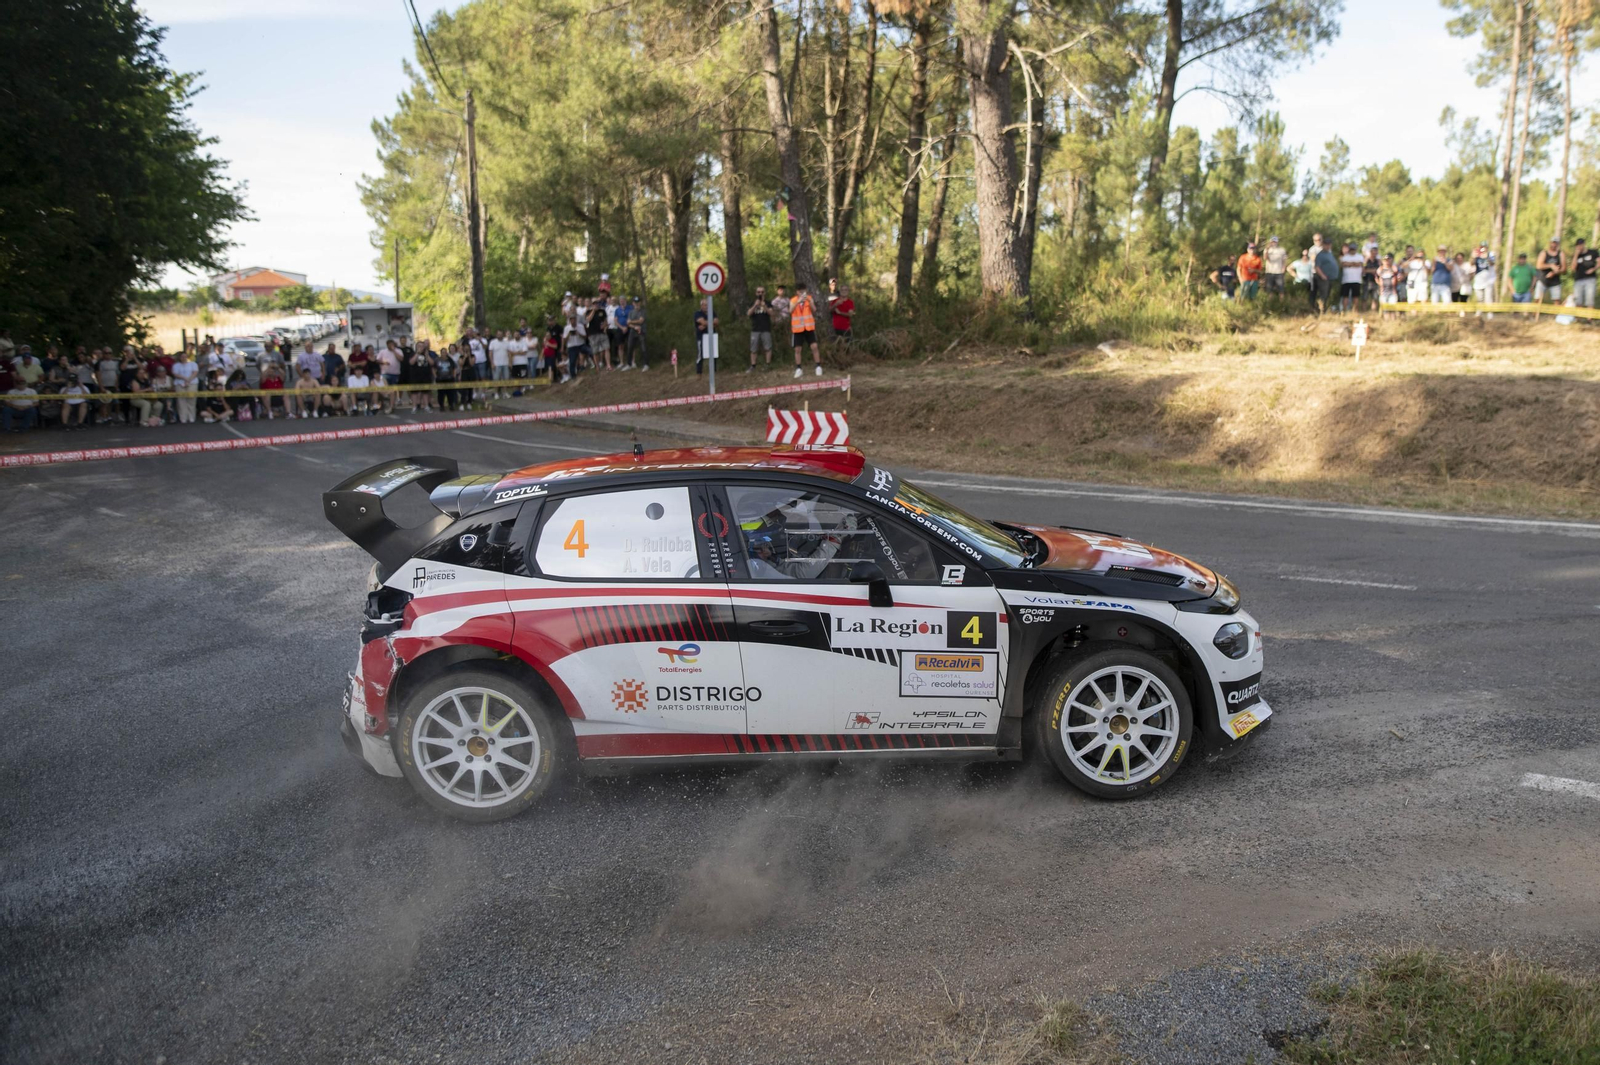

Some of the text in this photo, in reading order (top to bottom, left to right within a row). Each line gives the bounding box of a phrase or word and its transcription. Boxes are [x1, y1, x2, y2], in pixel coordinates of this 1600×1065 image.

[702, 273, 719, 284] 70
[4, 455, 30, 465] PUBLICO
[496, 485, 541, 500] TOPTUL
[865, 491, 983, 561] LANCIA-CORSEHF.COM
[564, 519, 589, 558] 4
[624, 536, 693, 553] D. Ruiloba
[623, 556, 672, 573] A. Vela
[1019, 608, 1055, 616] SPORTS
[835, 617, 865, 633] La
[961, 616, 983, 645] 4
[658, 666, 702, 674] TotalEnergies
[929, 658, 970, 669] Recalvi
[931, 680, 995, 689] recoletas salud
[656, 686, 762, 701] DISTRIGO
